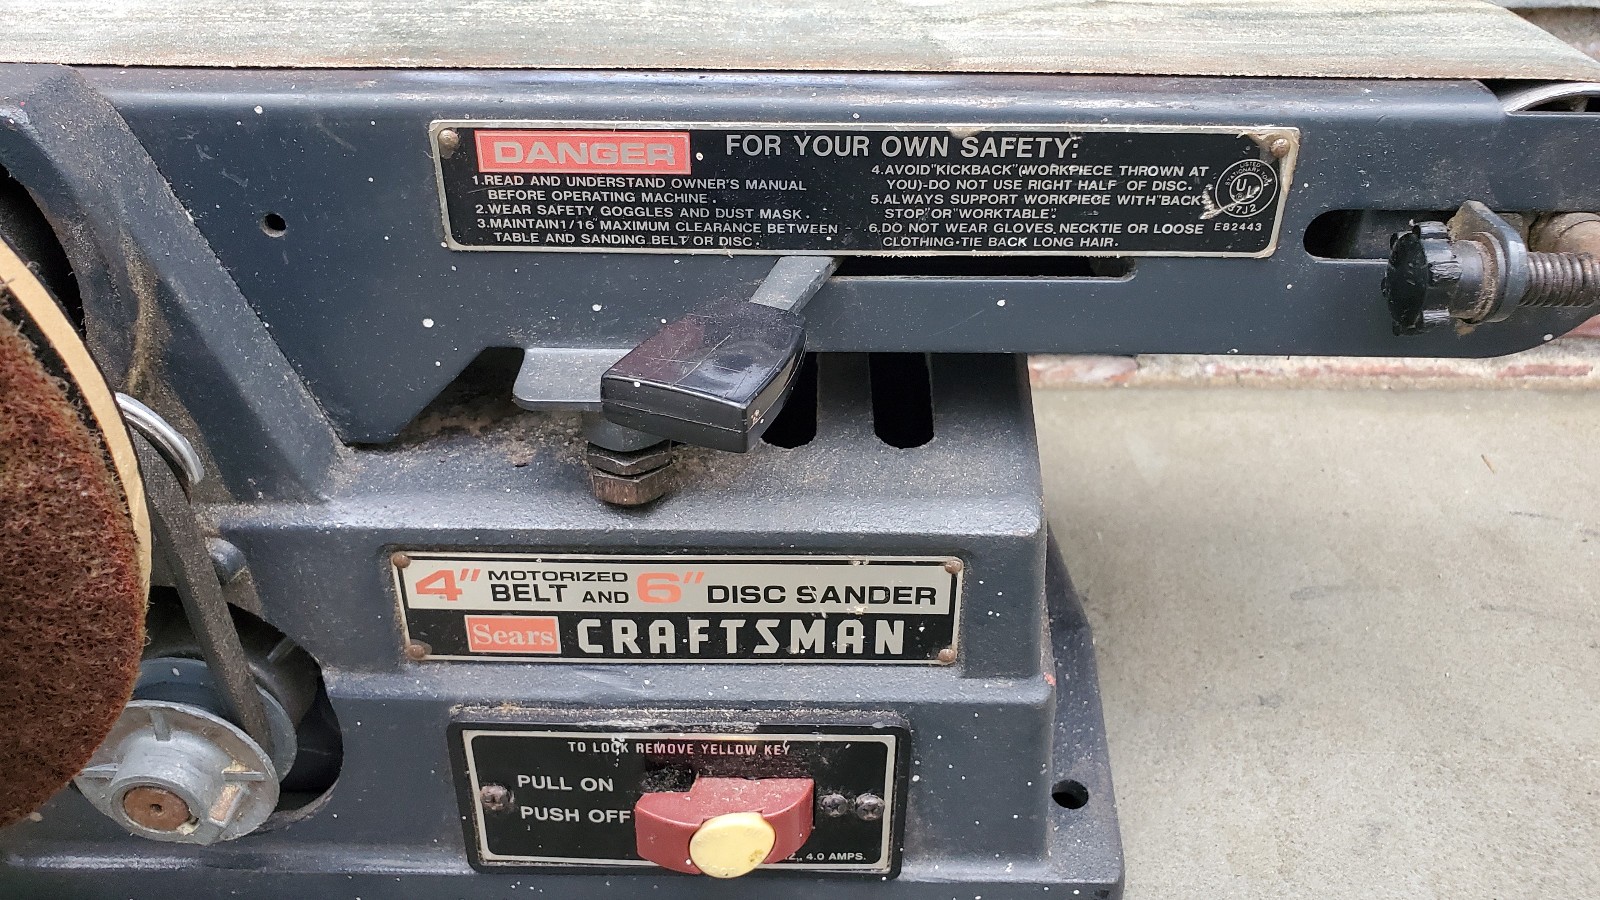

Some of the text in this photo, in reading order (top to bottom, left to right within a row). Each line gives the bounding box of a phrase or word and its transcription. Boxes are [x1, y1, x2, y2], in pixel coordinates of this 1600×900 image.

[493, 141, 675, 166] DANGER
[726, 134, 1078, 159] FOR YOUR OWN SAFETY:
[1120, 166, 1184, 177] THROWN
[1189, 166, 1210, 177] AT
[1225, 166, 1260, 186] STATIONARY
[530, 176, 560, 187] AND
[566, 177, 665, 189] UNDERSTAND
[671, 178, 740, 190] OWNER'S
[745, 180, 807, 191] MANUAL
[956, 180, 988, 190] NOT
[993, 180, 1022, 190] USE
[1027, 180, 1072, 191] RIGHT
[1078, 180, 1117, 191] HALF
[1126, 180, 1148, 191] OF
[1152, 180, 1193, 191] DISC.
[488, 190, 546, 200] BEFORE
[551, 190, 636, 202] OPERATING
[950, 194, 1018, 205] SUPPORT
[1024, 194, 1110, 206] WORKPIECE
[1117, 194, 1157, 206] WITH
[537, 205, 594, 216] SAFETY
[600, 206, 673, 218] GOGGLES
[680, 208, 710, 219] AND
[716, 208, 754, 219] DUST
[600, 220, 670, 232] MAXIMUM
[675, 222, 762, 234] CLEARANCE
[767, 223, 838, 234] BETWEEN
[908, 223, 940, 234] NOT
[945, 223, 988, 234] WEAR
[1060, 223, 1122, 234] NECKTIE
[1127, 223, 1148, 234] OR
[1154, 224, 1204, 234] LOOSE
[1214, 222, 1262, 232] E82443
[493, 232, 540, 243] TABLE
[546, 233, 576, 244] AND
[581, 234, 646, 245] SANDING
[652, 235, 689, 246] BELT
[693, 236, 714, 246] OR
[988, 237, 1028, 247] BACK
[1033, 237, 1074, 247] LONG
[1080, 237, 1118, 247] HAIR.
[488, 570, 628, 582] MOTORIZED
[491, 584, 568, 602] BELT
[582, 590, 629, 604] AND
[707, 585, 786, 604] DISC
[796, 586, 937, 606] SANDER
[472, 618, 905, 655] Sears CRAFTSMAN
[568, 742, 791, 756] TO LOCK REMOVE YELLOW KEY
[517, 774, 614, 792] PULL ON
[520, 806, 631, 824] PUSH OFF
[806, 852, 825, 860] 4.0
[828, 852, 866, 860] AMPS.
